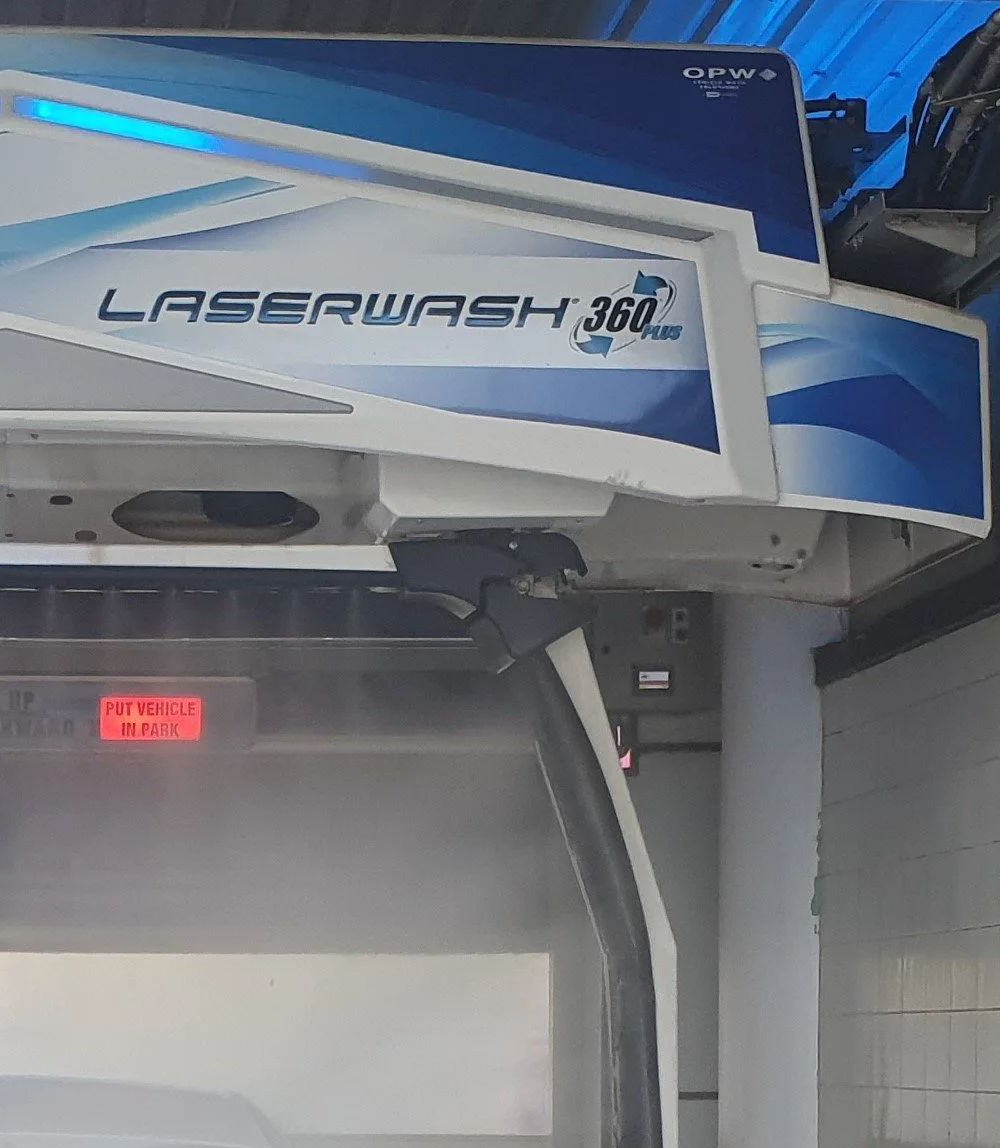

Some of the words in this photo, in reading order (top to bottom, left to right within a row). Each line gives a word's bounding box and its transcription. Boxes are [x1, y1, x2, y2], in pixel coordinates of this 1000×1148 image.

[682, 67, 757, 79] OPW
[98, 288, 571, 329] LASERWASH
[582, 296, 658, 333] 360
[641, 323, 683, 341] PLUS
[8, 689, 35, 709] UP
[105, 701, 133, 716] PUT
[137, 702, 196, 716] VEHICLE
[121, 722, 136, 737] IN
[141, 723, 180, 737] PARK
